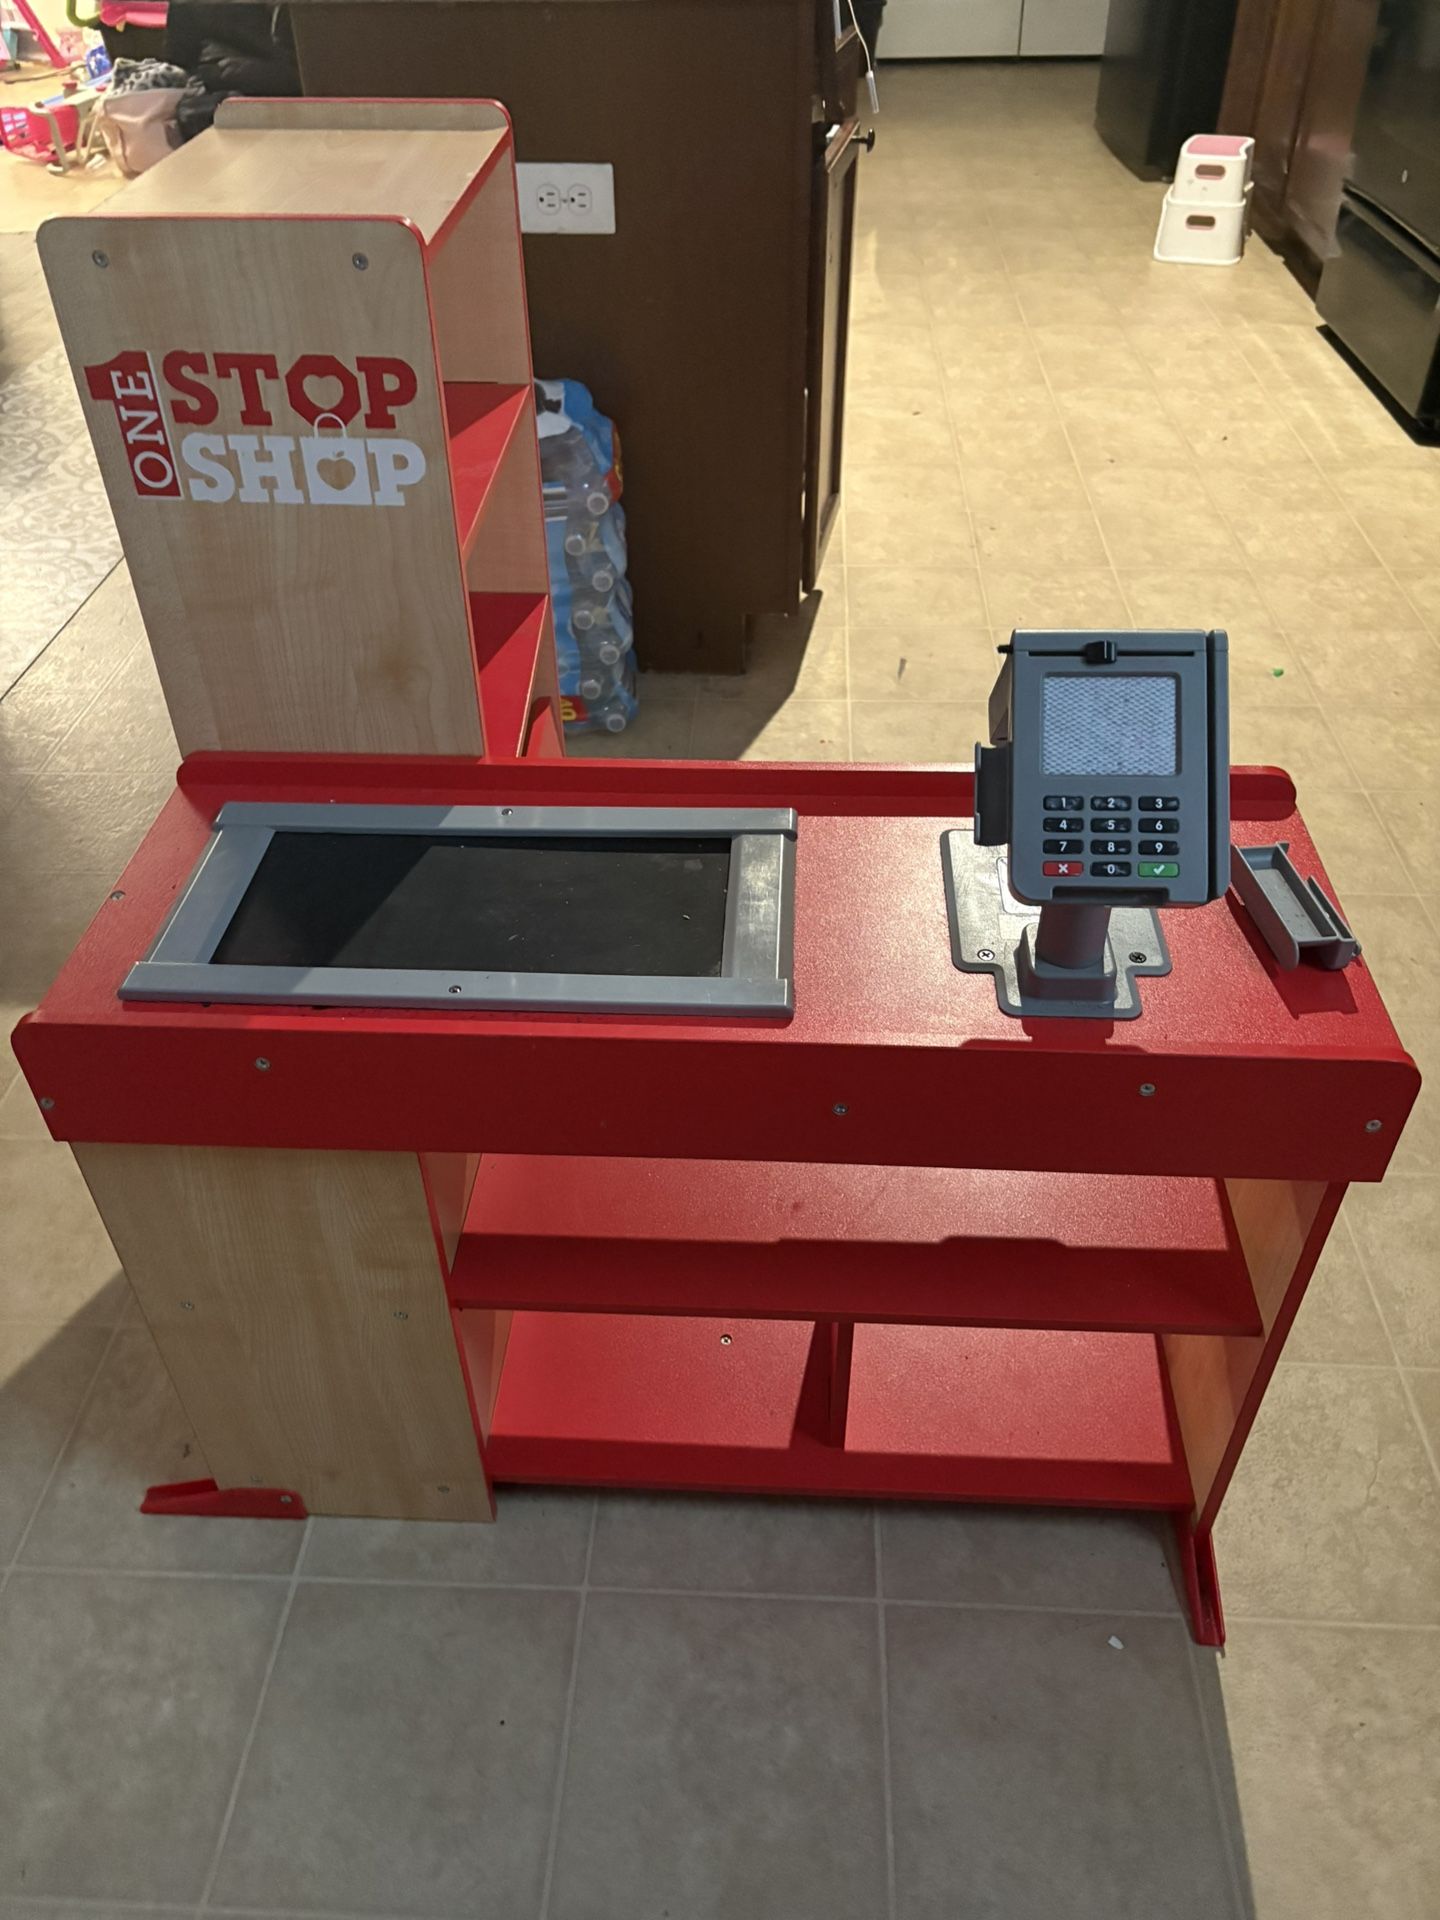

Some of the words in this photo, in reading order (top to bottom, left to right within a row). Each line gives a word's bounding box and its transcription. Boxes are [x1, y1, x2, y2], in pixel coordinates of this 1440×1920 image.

[163, 350, 418, 430] STOP
[110, 370, 173, 489] ONE
[181, 432, 427, 507] SHOP
[1061, 797, 1067, 808] 1
[1107, 797, 1115, 808] 2
[1155, 798, 1163, 809] 3
[1059, 820, 1067, 830] 4
[1107, 820, 1115, 830] 5
[1155, 820, 1163, 831] 6
[1059, 841, 1067, 852] 7
[1107, 842, 1115, 852] 8
[1155, 842, 1163, 853] 9
[1107, 864, 1115, 874] 0
